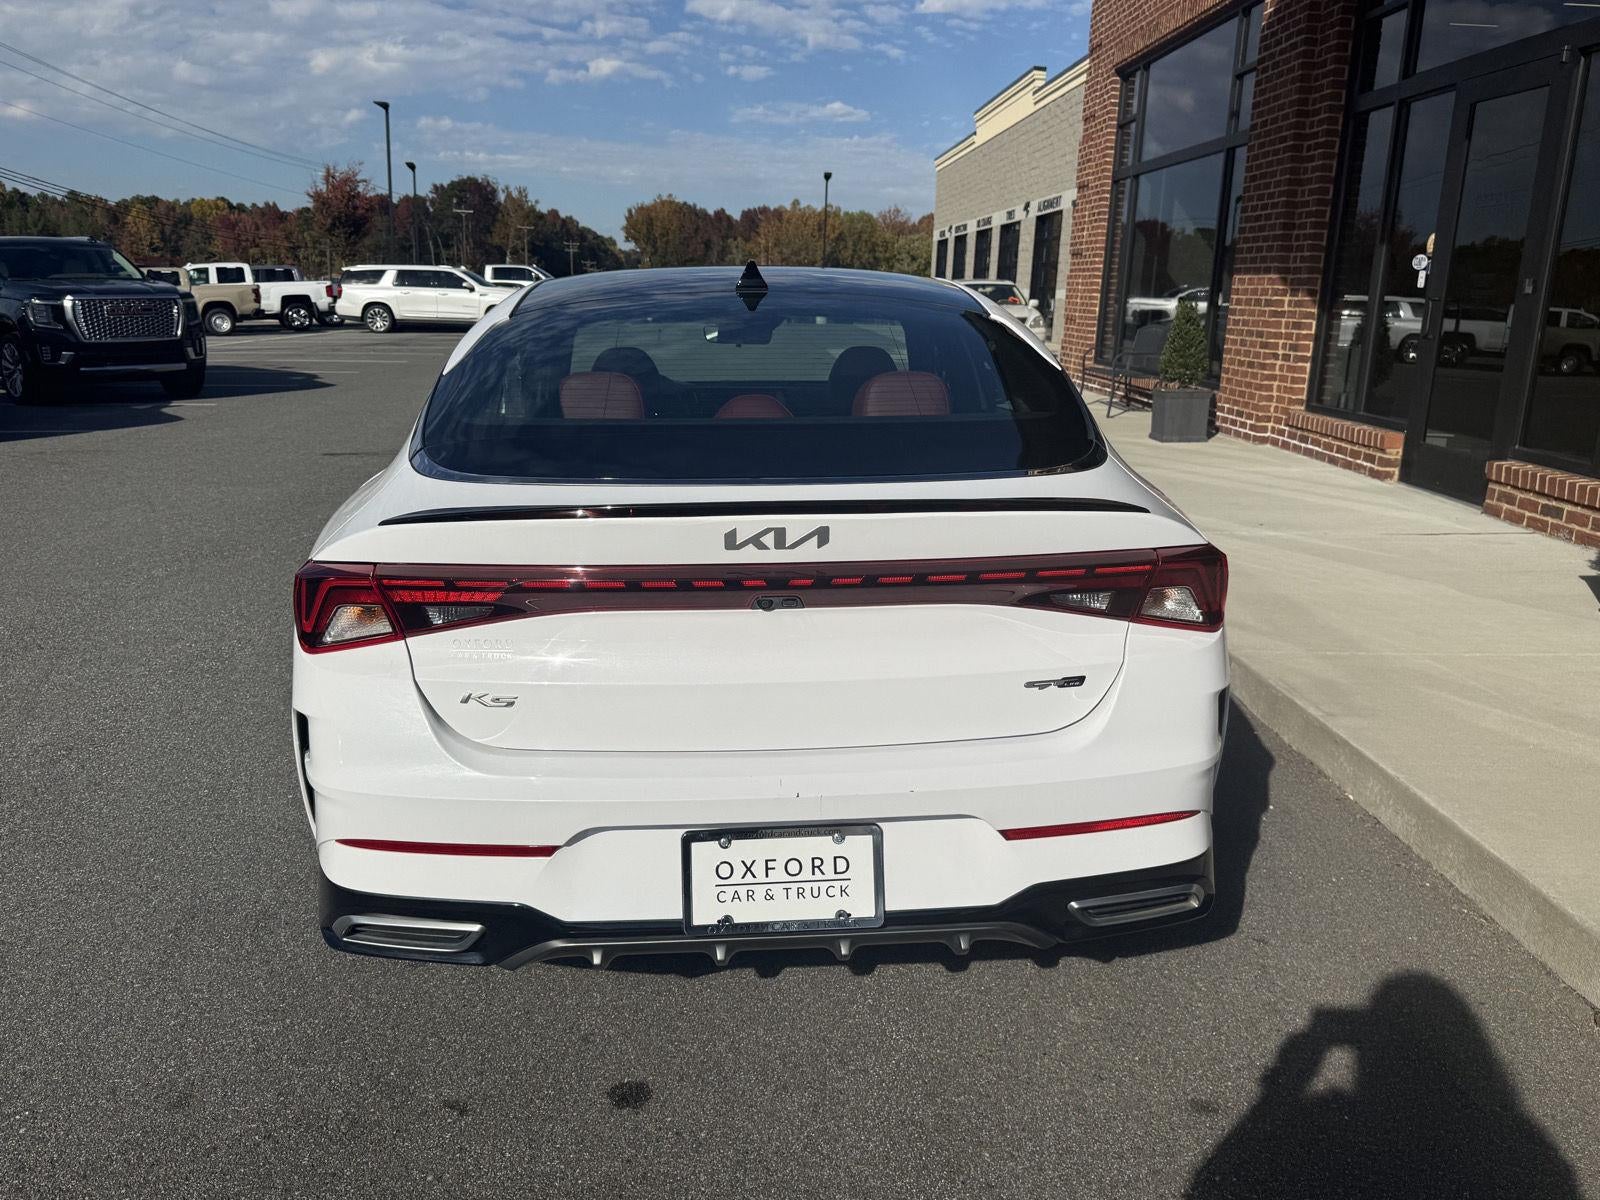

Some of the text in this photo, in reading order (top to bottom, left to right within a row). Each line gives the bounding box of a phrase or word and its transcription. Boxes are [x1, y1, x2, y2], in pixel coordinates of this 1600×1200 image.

[724, 526, 829, 550] KIA
[452, 639, 513, 649] OXFORD
[482, 652, 513, 660] TRUCK
[715, 855, 850, 880] OXFORD
[716, 885, 850, 904] CAR & TRUCK
